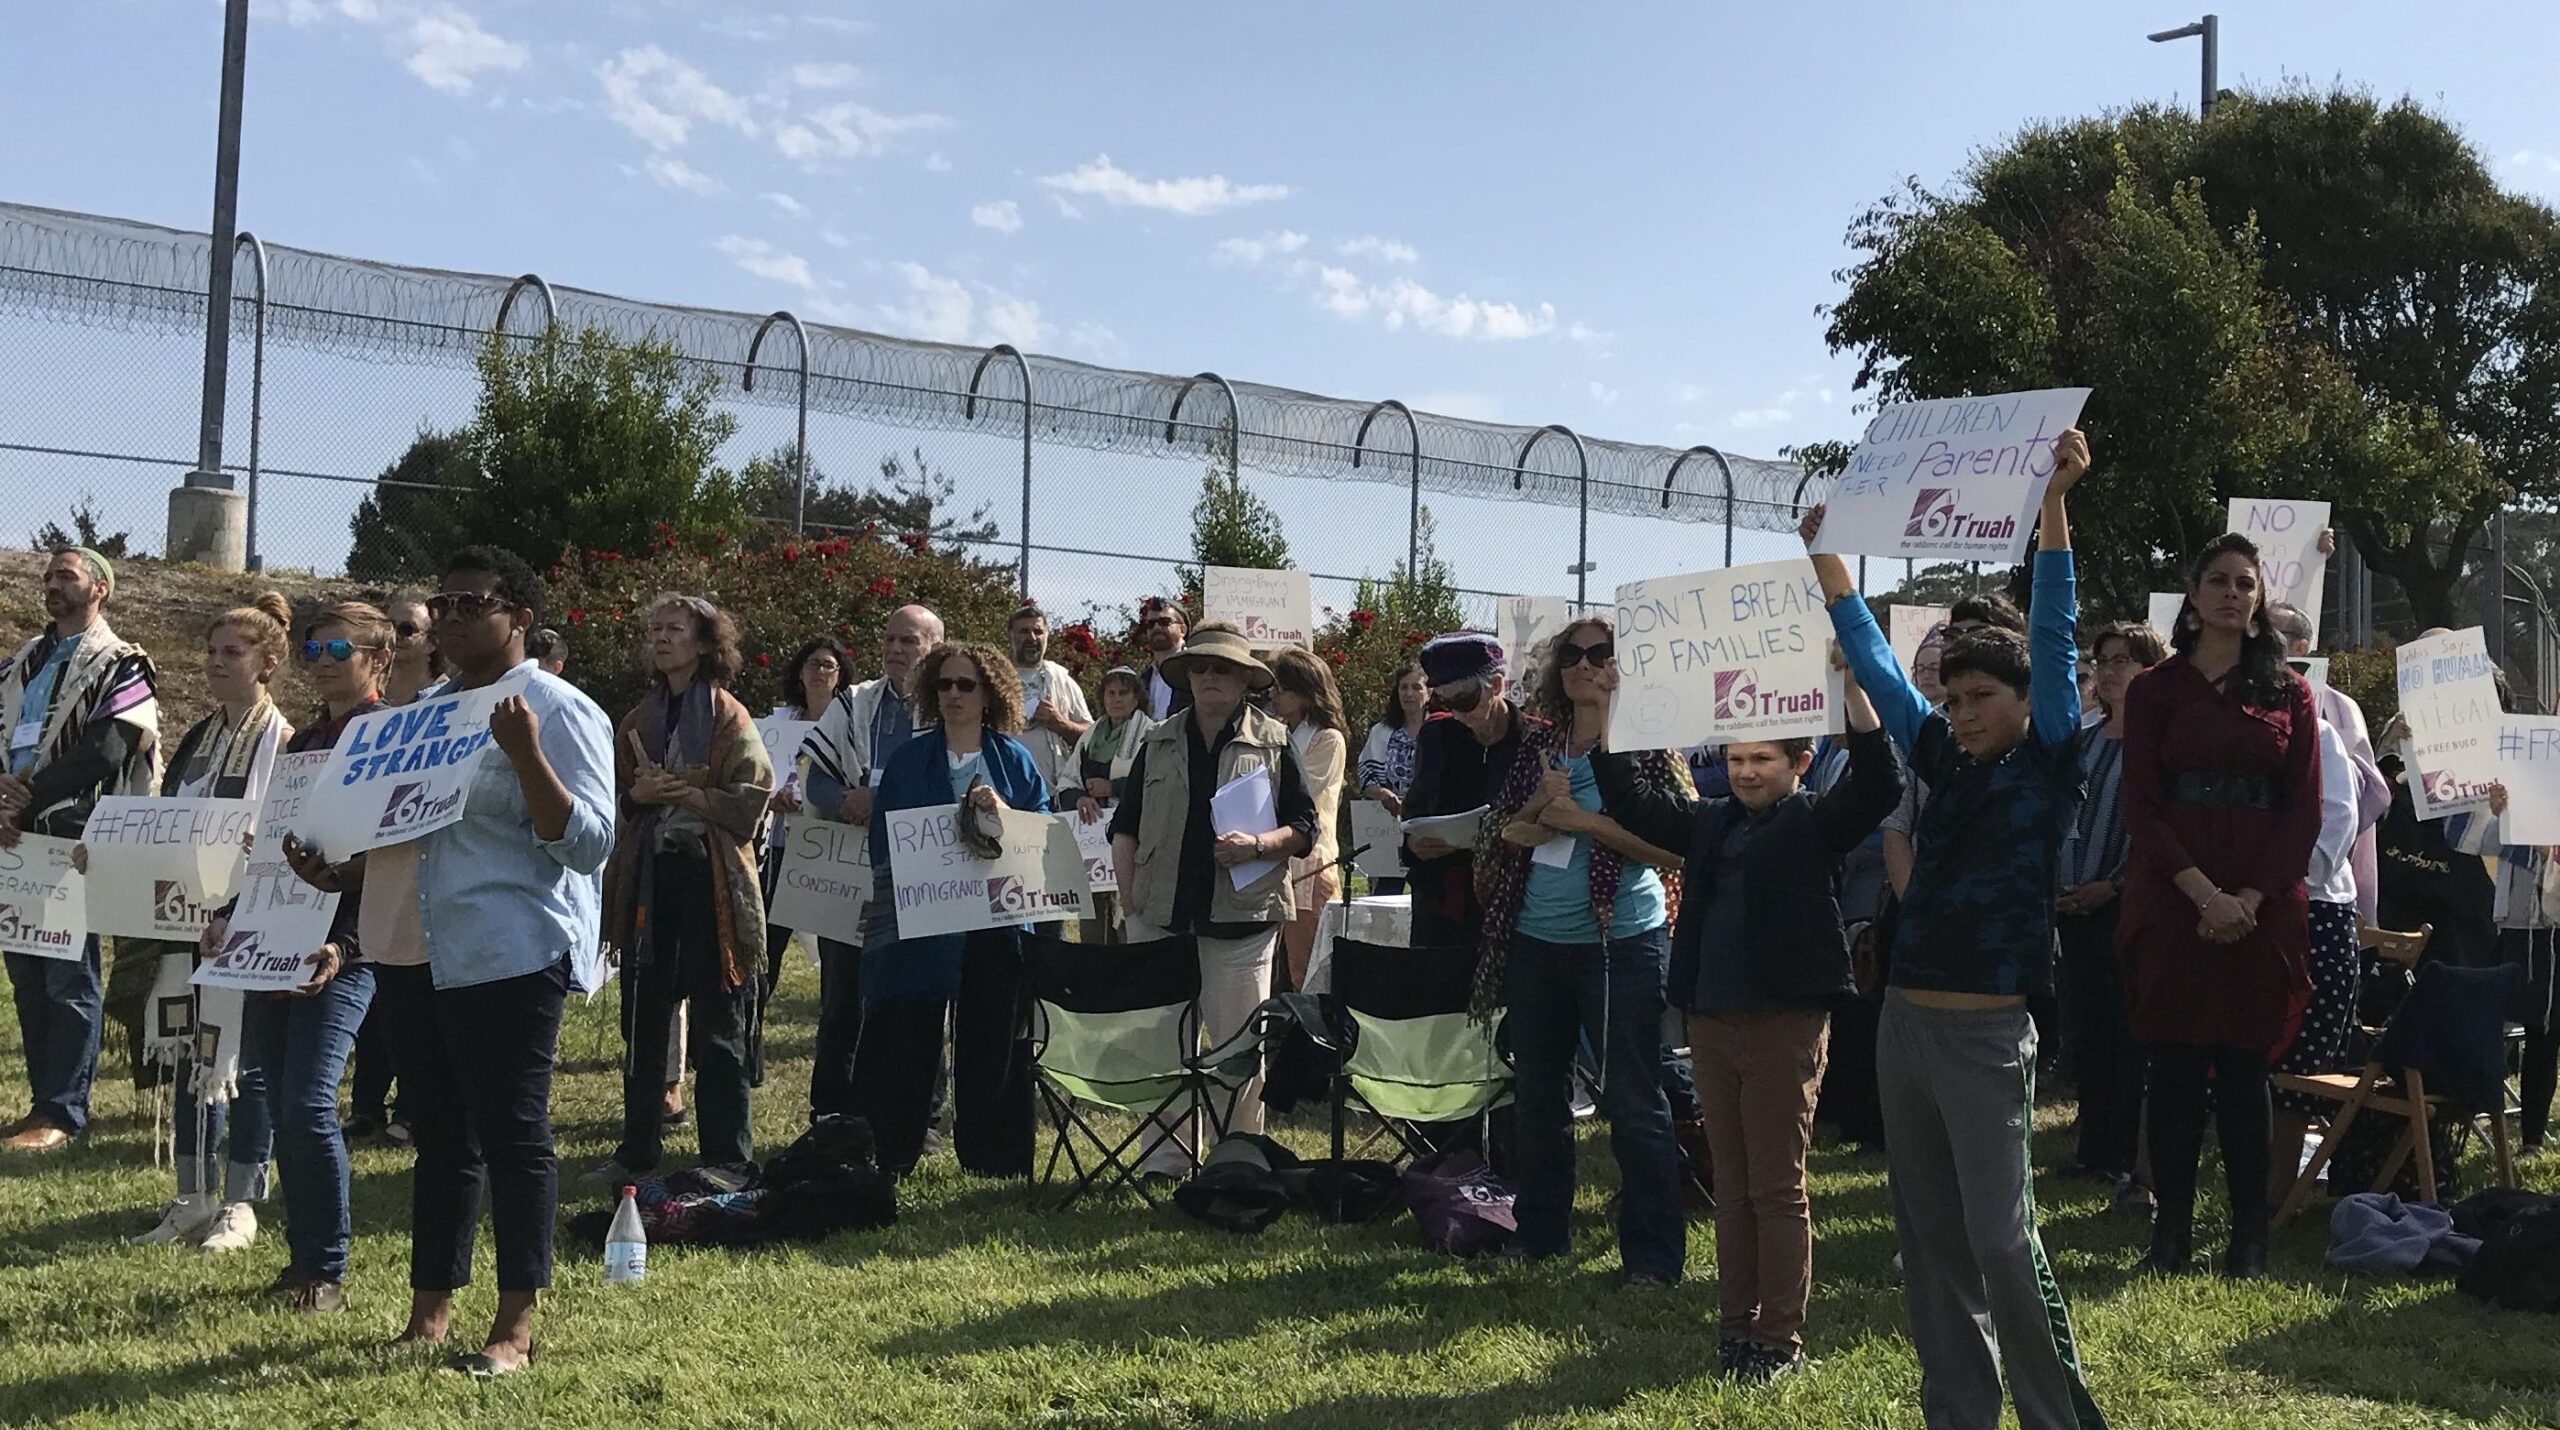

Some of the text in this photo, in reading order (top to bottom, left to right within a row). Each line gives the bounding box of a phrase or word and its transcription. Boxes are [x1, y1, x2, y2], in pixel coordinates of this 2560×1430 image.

[1869, 400, 2020, 445] CHILDREN
[1849, 452, 1907, 473] NEED
[1907, 415, 2058, 484] Parents
[1834, 476, 1888, 497] THEIR
[1952, 513, 2015, 538] T'ruah
[2248, 505, 2295, 532] NO
[2261, 561, 2304, 590] NO
[1227, 594, 1287, 608] IMMIGRANT
[1616, 580, 1645, 604] ICE
[1731, 577, 1826, 622] BREAK
[1618, 587, 1707, 638] DON'T
[1269, 628, 1302, 640] T'ruah
[1618, 625, 1805, 677] UP FAMILIES
[2400, 652, 2492, 693] NO HUMAN
[1760, 688, 1824, 715] T'ruah
[346, 701, 459, 756] LOVE
[285, 775, 308, 790] AND
[265, 798, 300, 824] ICE
[420, 786, 461, 820] T'ruah
[941, 851, 980, 866] STA
[787, 868, 862, 900] CONSENT
[897, 880, 984, 911] IMMIGRANTS
[1027, 889, 1080, 908] T'ruah
[21, 924, 72, 946] T'ruah
[252, 950, 301, 972] T'ruah
